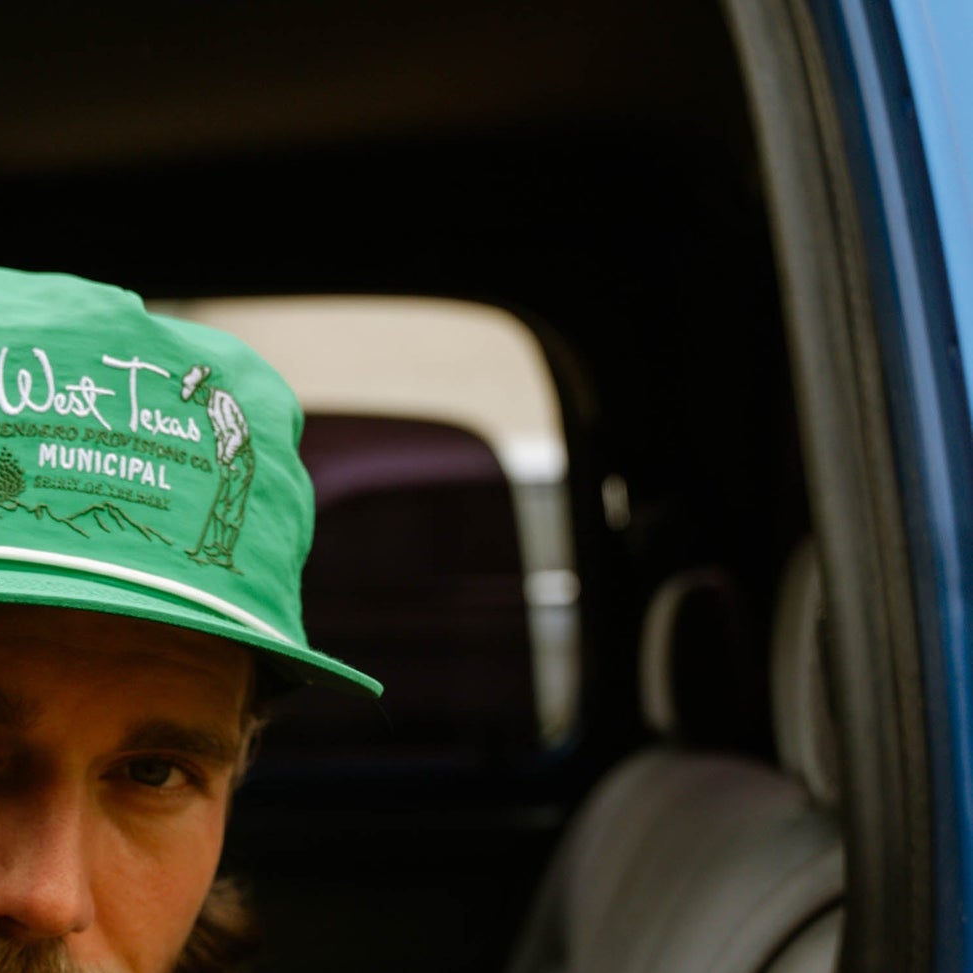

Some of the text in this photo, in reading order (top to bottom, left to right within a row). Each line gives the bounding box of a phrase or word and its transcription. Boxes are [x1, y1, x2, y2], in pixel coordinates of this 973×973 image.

[101, 354, 200, 442] Texas
[39, 443, 171, 489] MUNICIPAL
[82, 427, 187, 464] PROVISIONS
